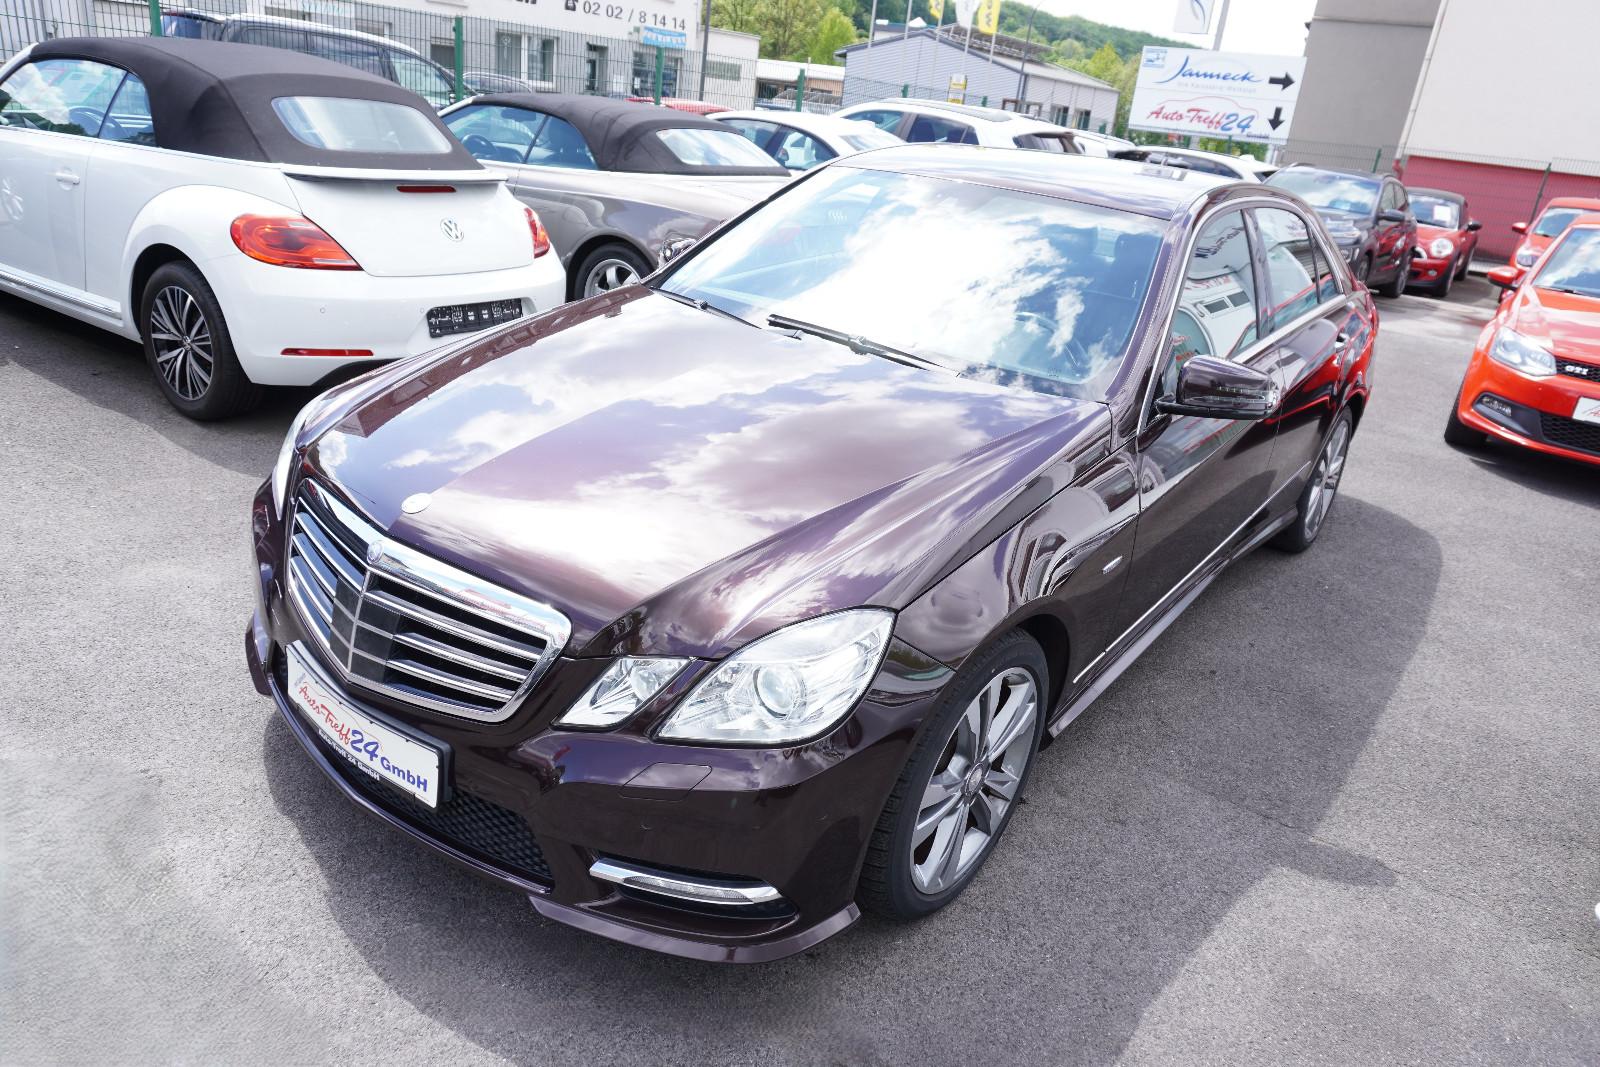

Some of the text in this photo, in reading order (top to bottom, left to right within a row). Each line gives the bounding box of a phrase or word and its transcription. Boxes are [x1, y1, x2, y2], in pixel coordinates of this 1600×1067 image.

[583, 1, 600, 15] 02
[606, 4, 622, 19] 02
[639, 10, 647, 23] 8
[653, 13, 666, 27] 14
[672, 17, 685, 30] 14
[1565, 365, 1589, 376] GTI
[381, 756, 427, 792] GmbH
